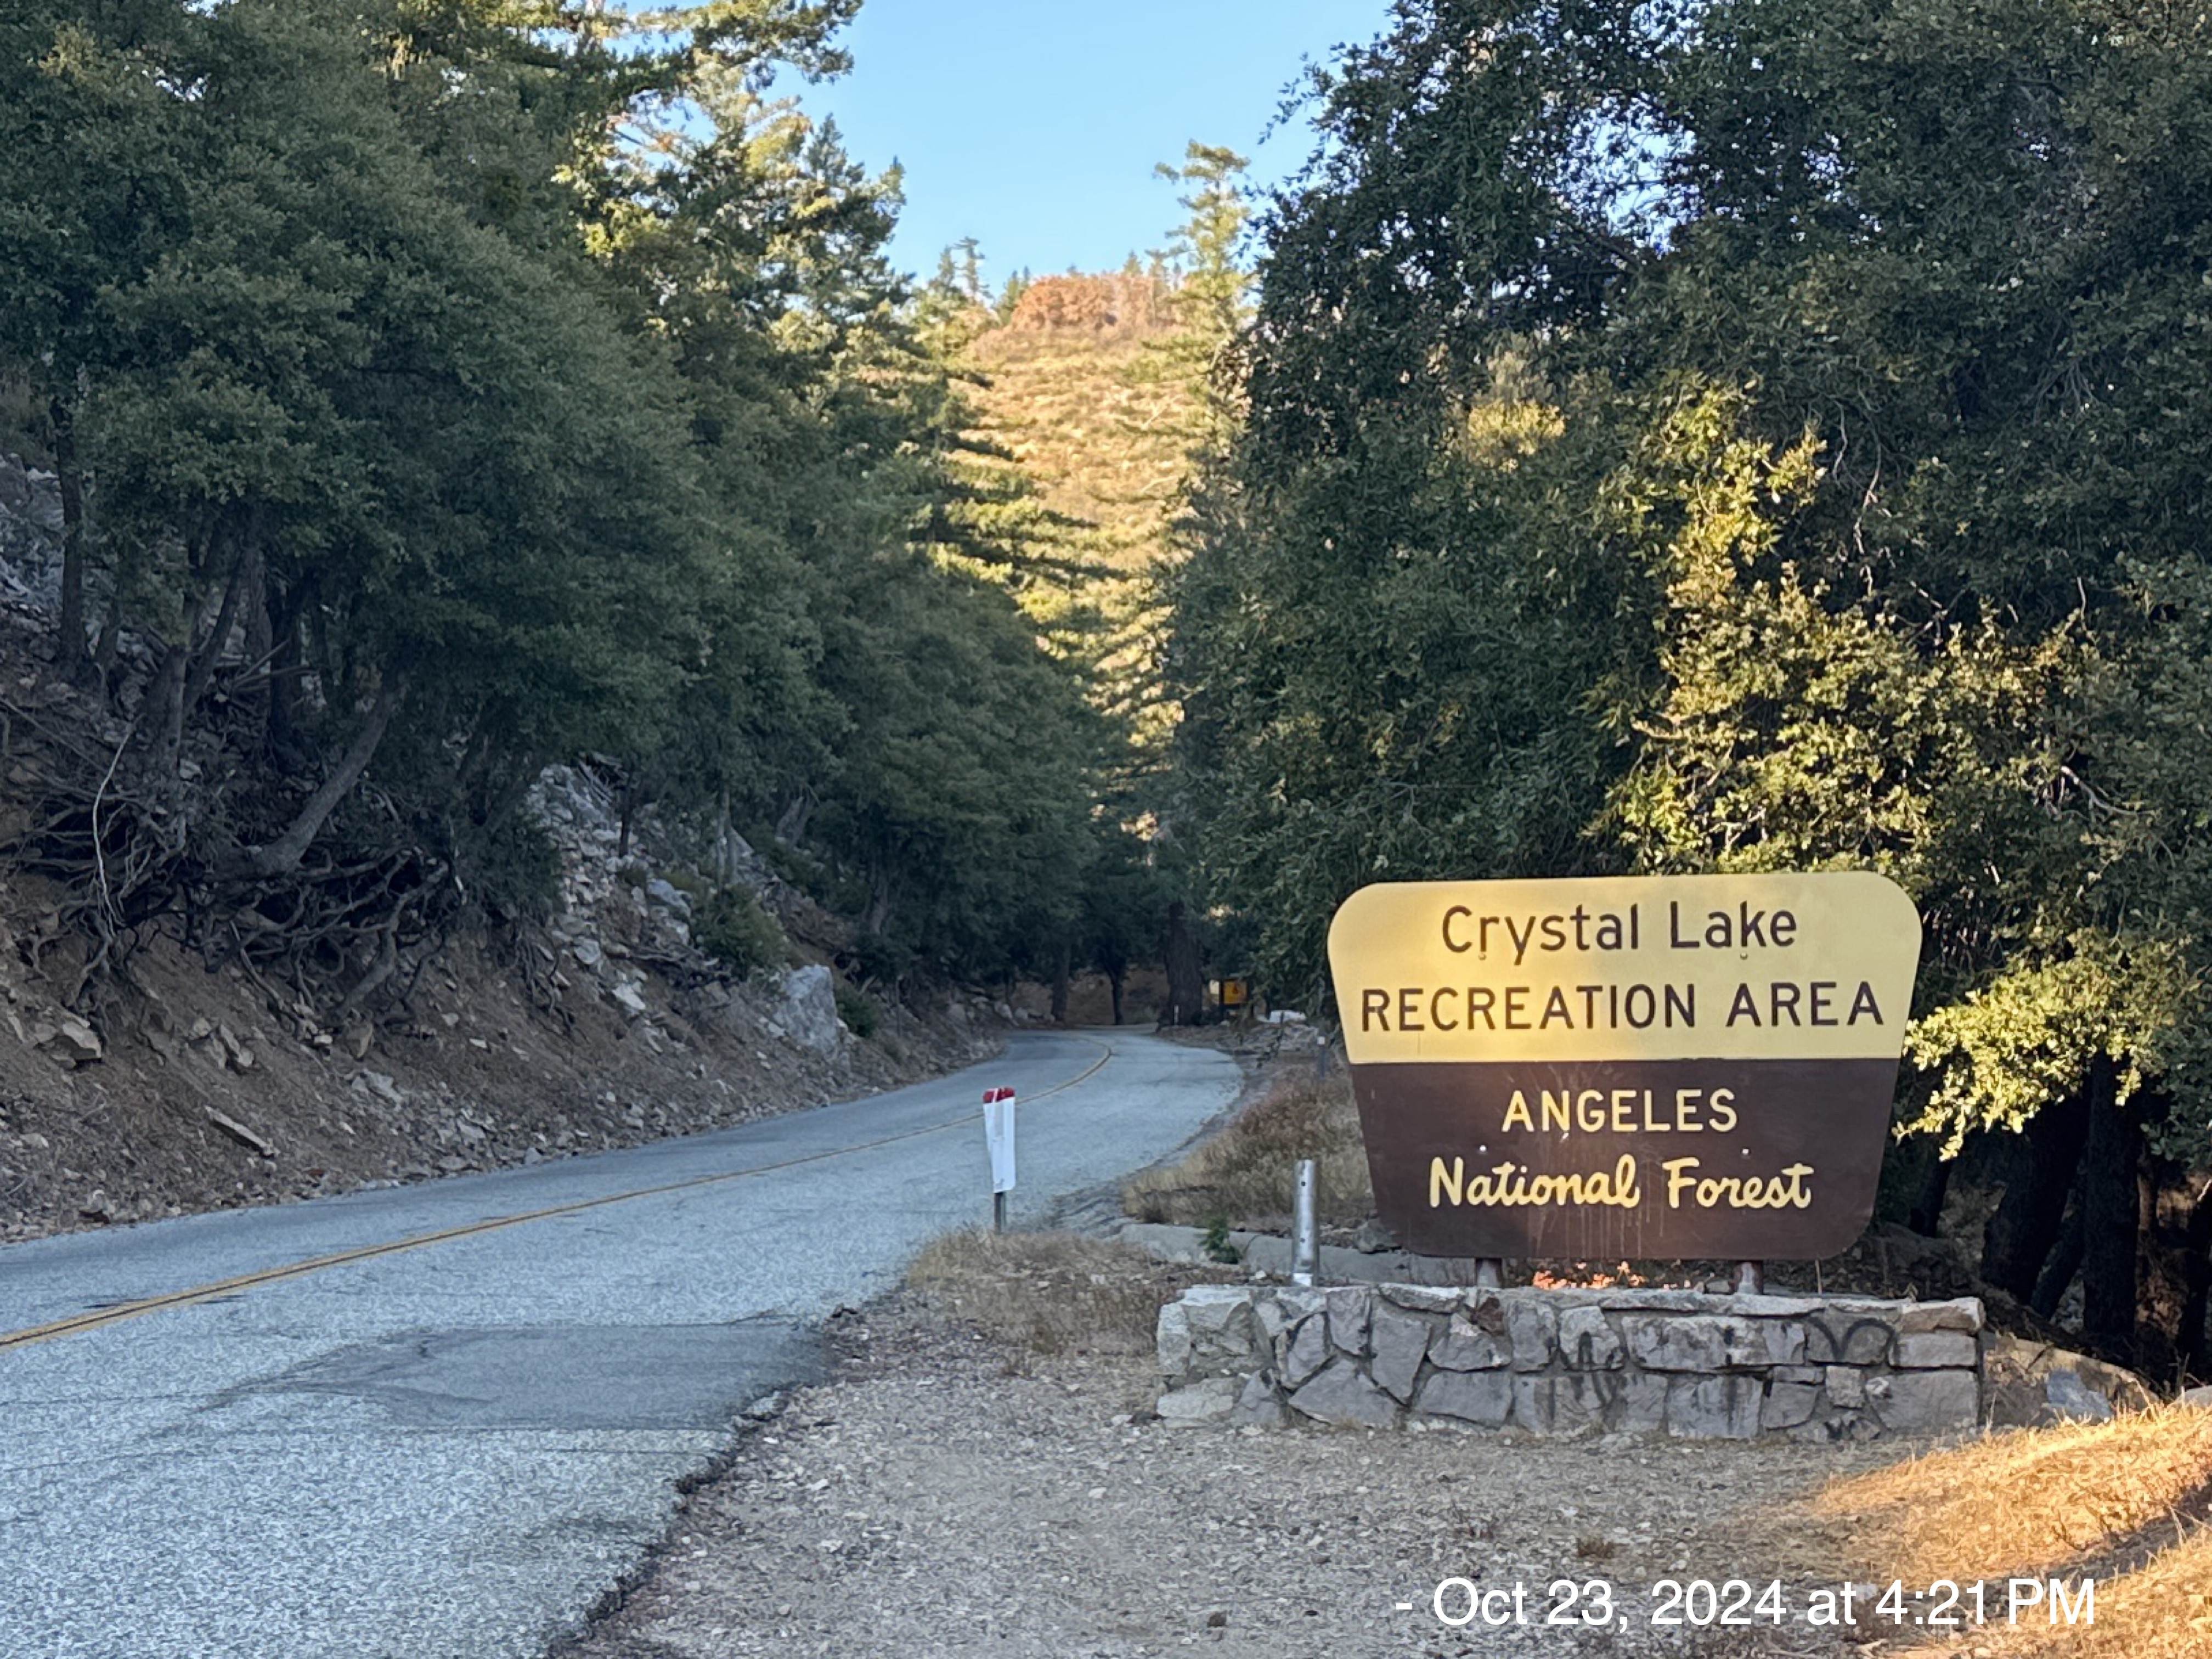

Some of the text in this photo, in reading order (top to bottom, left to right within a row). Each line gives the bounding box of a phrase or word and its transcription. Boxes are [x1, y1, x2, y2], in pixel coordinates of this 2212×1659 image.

[1443, 901, 1796, 965] Crystal Lake
[1362, 981, 1883, 1032] RECREATION AREA
[1502, 1089, 1737, 1132] ANGELES
[1430, 1154, 1814, 1209] National Forest
